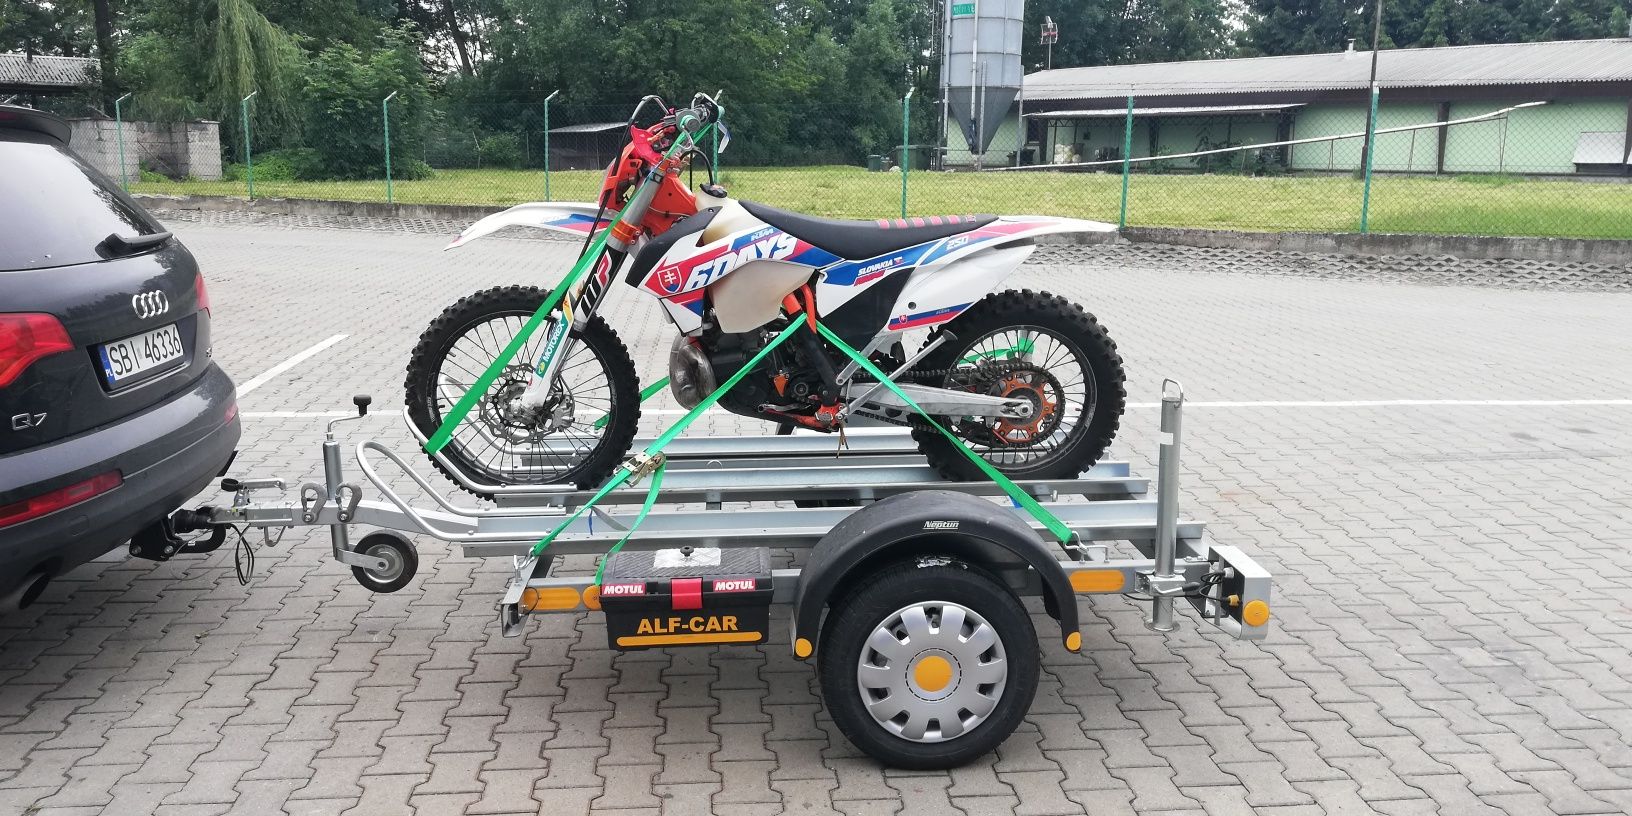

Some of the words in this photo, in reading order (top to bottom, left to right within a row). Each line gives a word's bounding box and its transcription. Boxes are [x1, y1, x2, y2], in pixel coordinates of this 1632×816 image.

[946, 236, 969, 251] 250
[683, 233, 797, 293] 6DAYS
[858, 259, 893, 276] SLOVAKIA
[109, 340, 140, 376] SBI
[144, 326, 181, 364] 46336
[542, 323, 565, 363] MOTOREX
[105, 368, 114, 378] PL
[11, 412, 47, 431] Q7
[923, 520, 960, 530] Neptun
[603, 584, 644, 595] MOTUL
[715, 580, 755, 592] MOTUL
[636, 615, 739, 635] ALF-CAR
